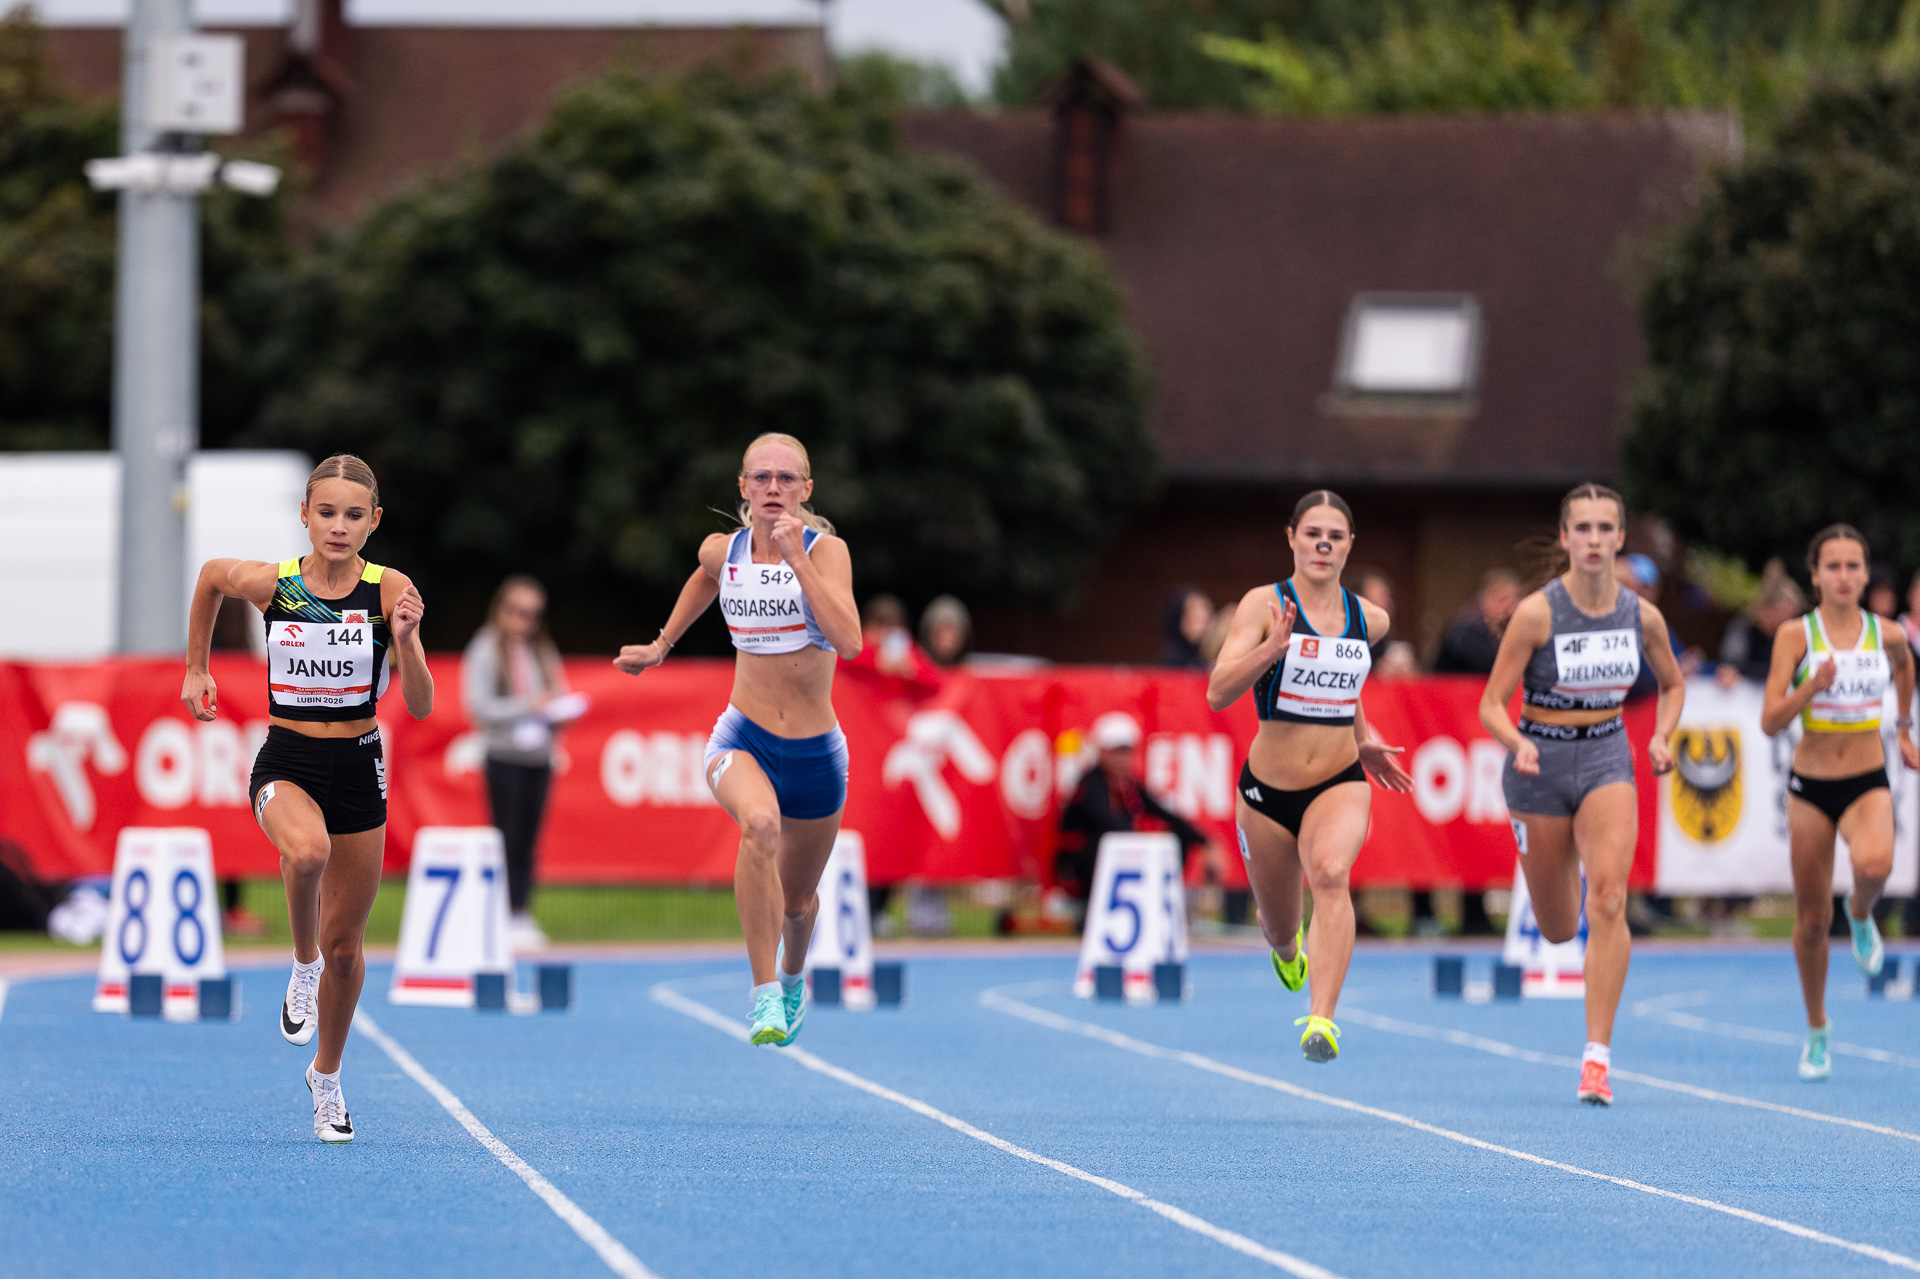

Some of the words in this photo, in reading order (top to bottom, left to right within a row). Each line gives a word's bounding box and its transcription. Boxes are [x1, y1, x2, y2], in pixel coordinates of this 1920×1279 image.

[760, 569, 794, 585] 549
[722, 597, 800, 617] KOSIARSKA
[279, 640, 305, 648] ORLEN
[327, 628, 363, 646] 144
[761, 635, 780, 643] 2026
[1335, 643, 1363, 661] 866
[286, 657, 354, 678] JANUS
[1291, 667, 1360, 690] ZACZEK
[296, 696, 322, 704] LUBIN
[323, 696, 344, 705] 2026
[359, 731, 380, 746] NIKE
[119, 868, 149, 966] 8
[172, 867, 205, 967] 8
[424, 867, 461, 961] 7
[1105, 871, 1142, 954] 5
